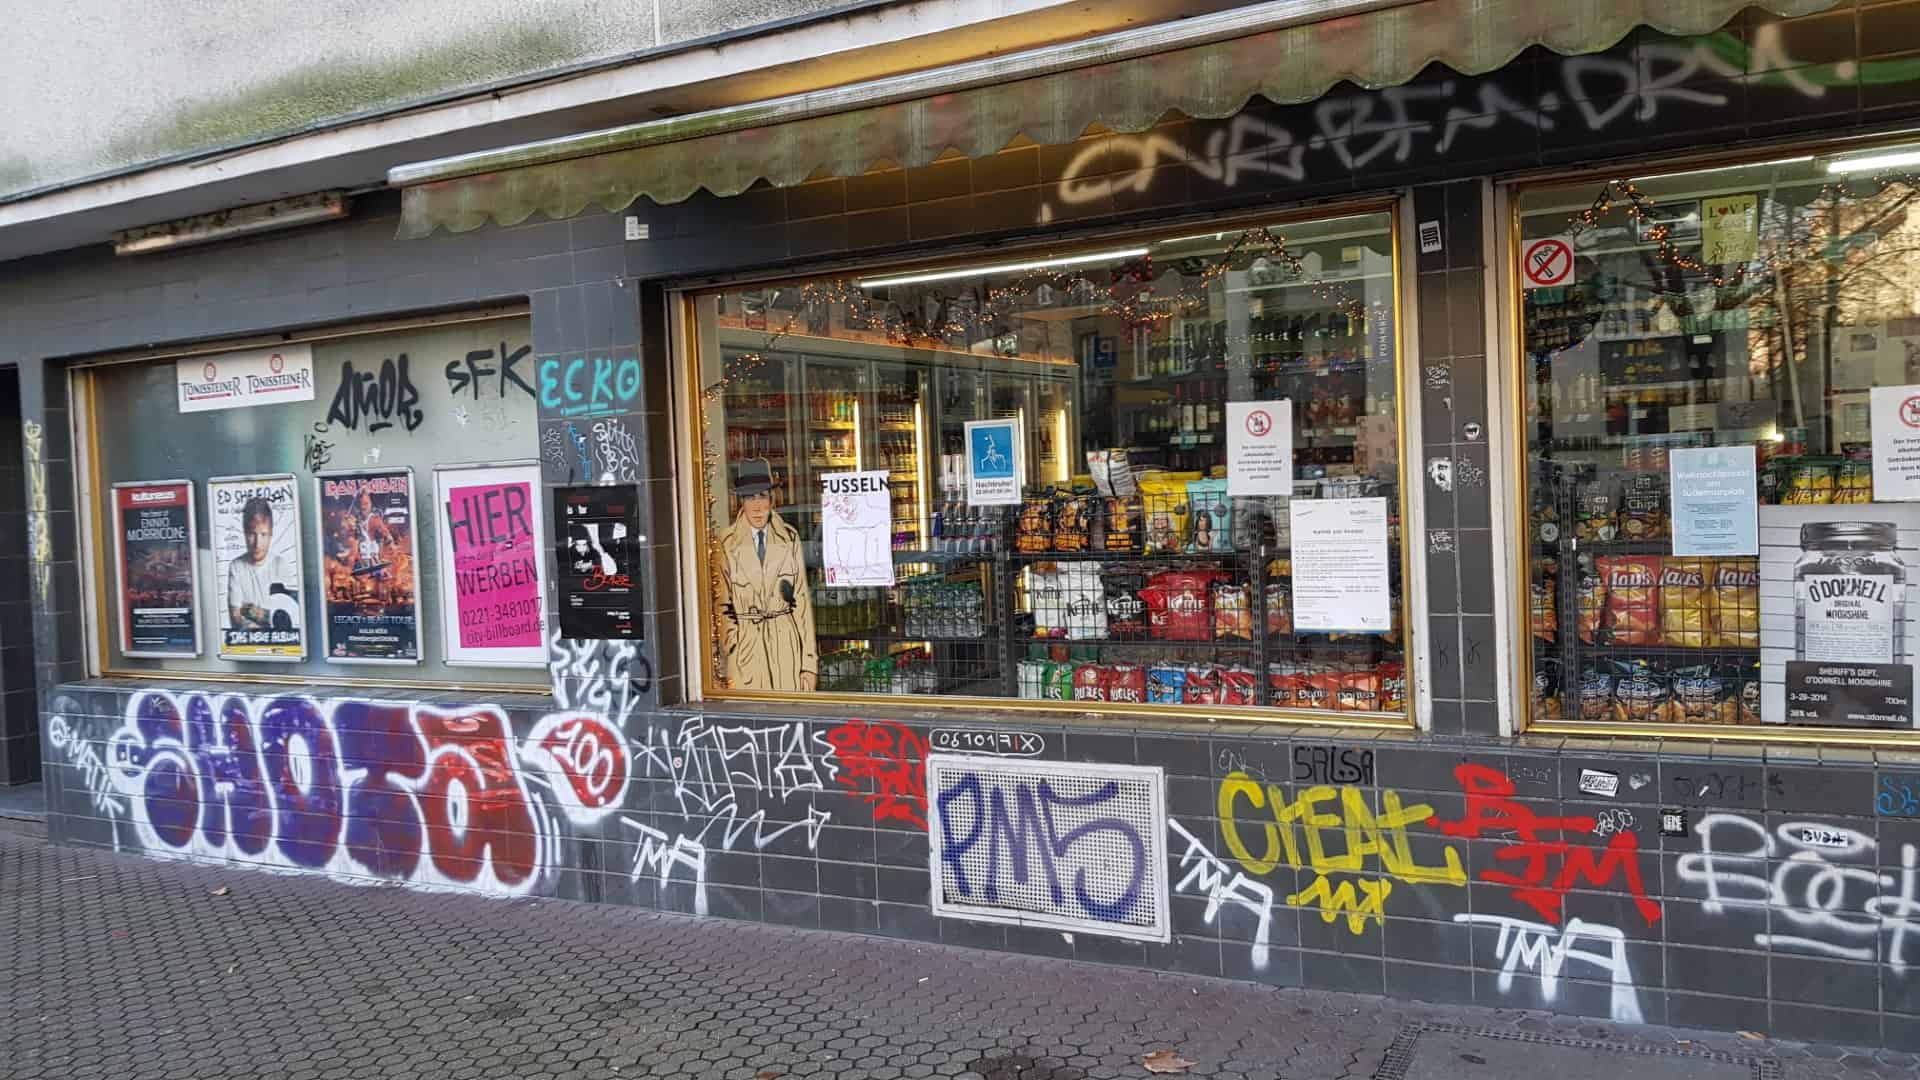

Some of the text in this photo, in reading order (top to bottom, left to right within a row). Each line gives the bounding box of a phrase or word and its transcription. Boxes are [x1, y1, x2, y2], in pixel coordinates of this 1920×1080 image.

[446, 341, 536, 400] SFK
[540, 358, 641, 408] ECKO
[820, 477, 890, 494] FUSSELN
[446, 486, 532, 552] HIER
[456, 556, 538, 597] WERBEN
[1809, 578, 1887, 603] O'DONNELL
[462, 597, 543, 626] 0221-3481017
[1294, 746, 1373, 784] SALSA
